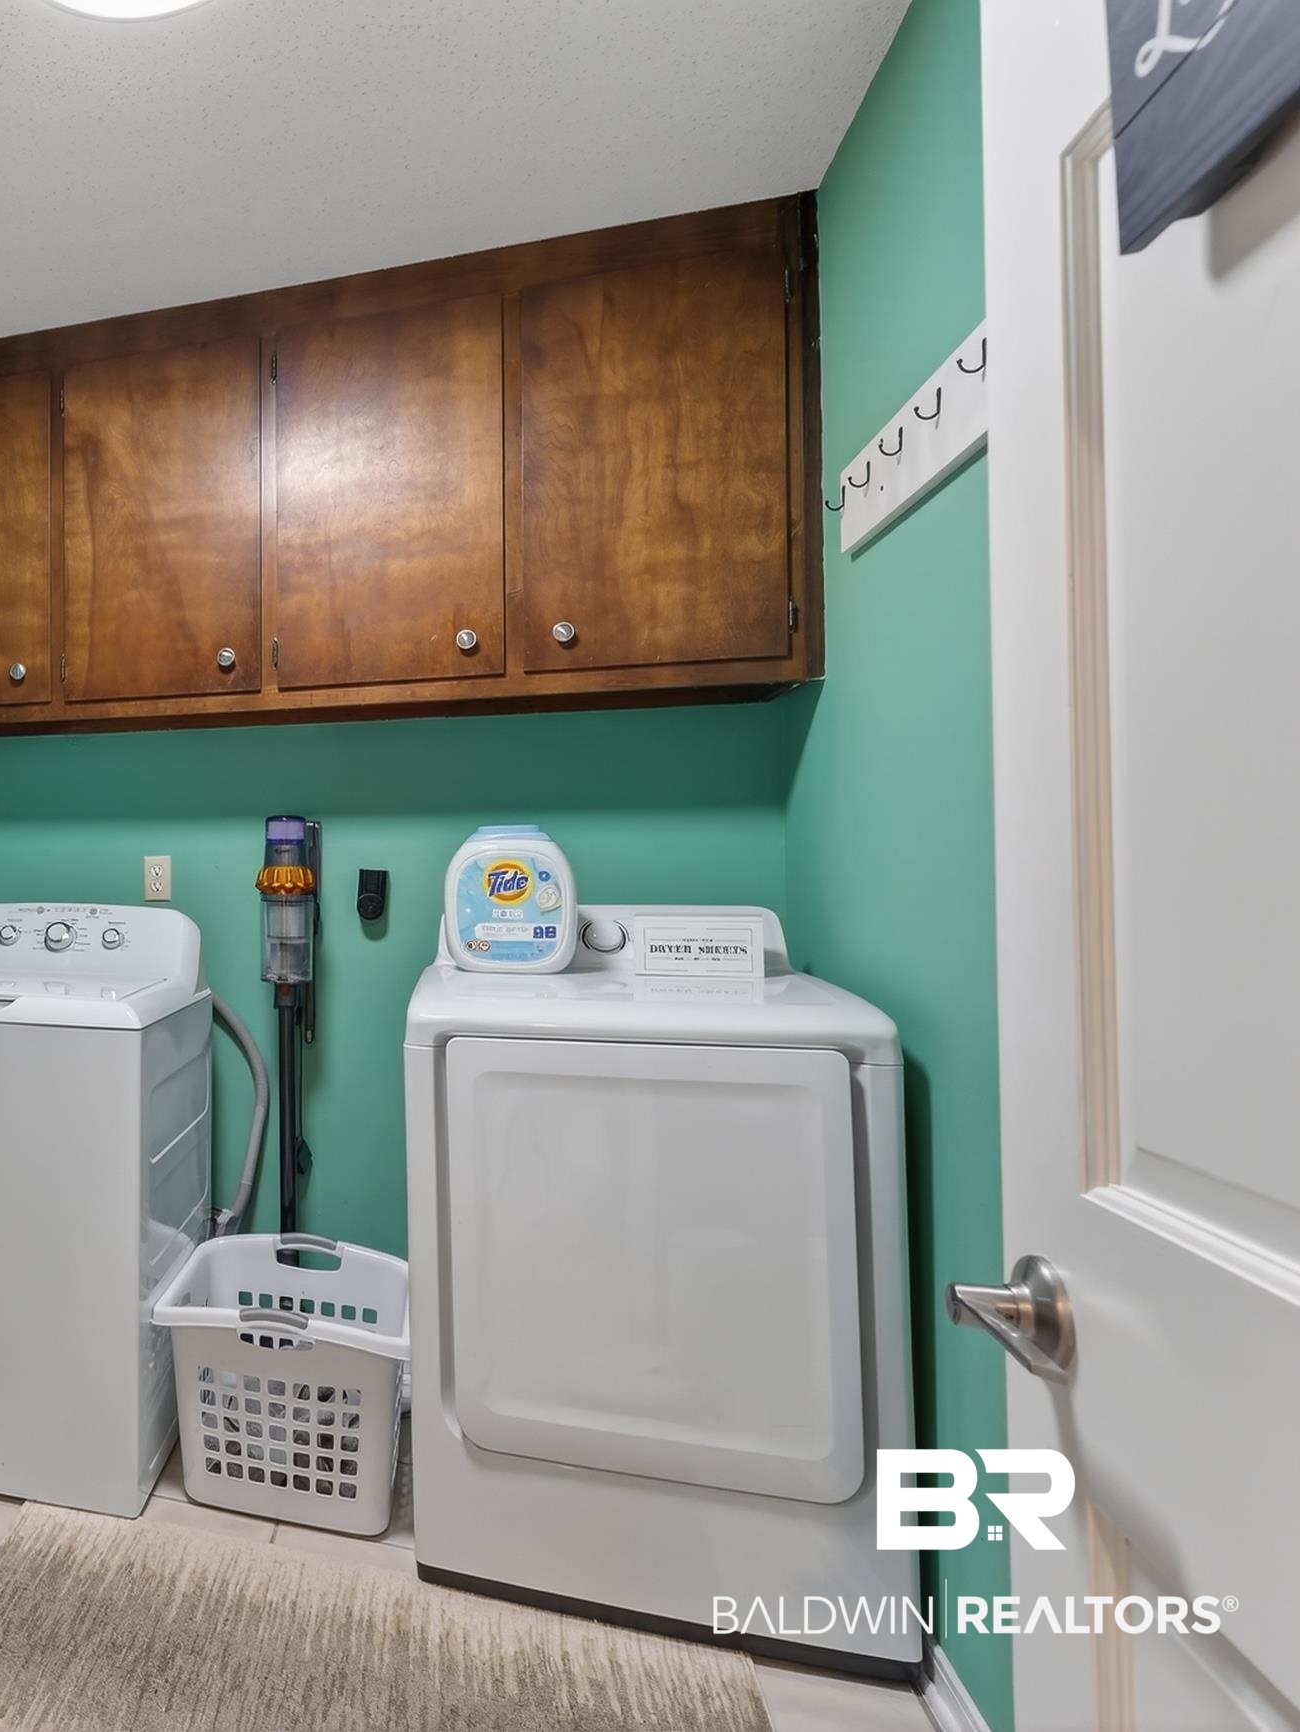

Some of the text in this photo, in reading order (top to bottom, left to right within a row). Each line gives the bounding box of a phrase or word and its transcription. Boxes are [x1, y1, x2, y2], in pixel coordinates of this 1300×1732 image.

[487, 867, 530, 898] Tide
[649, 944, 748, 955] DRYER SHEETS
